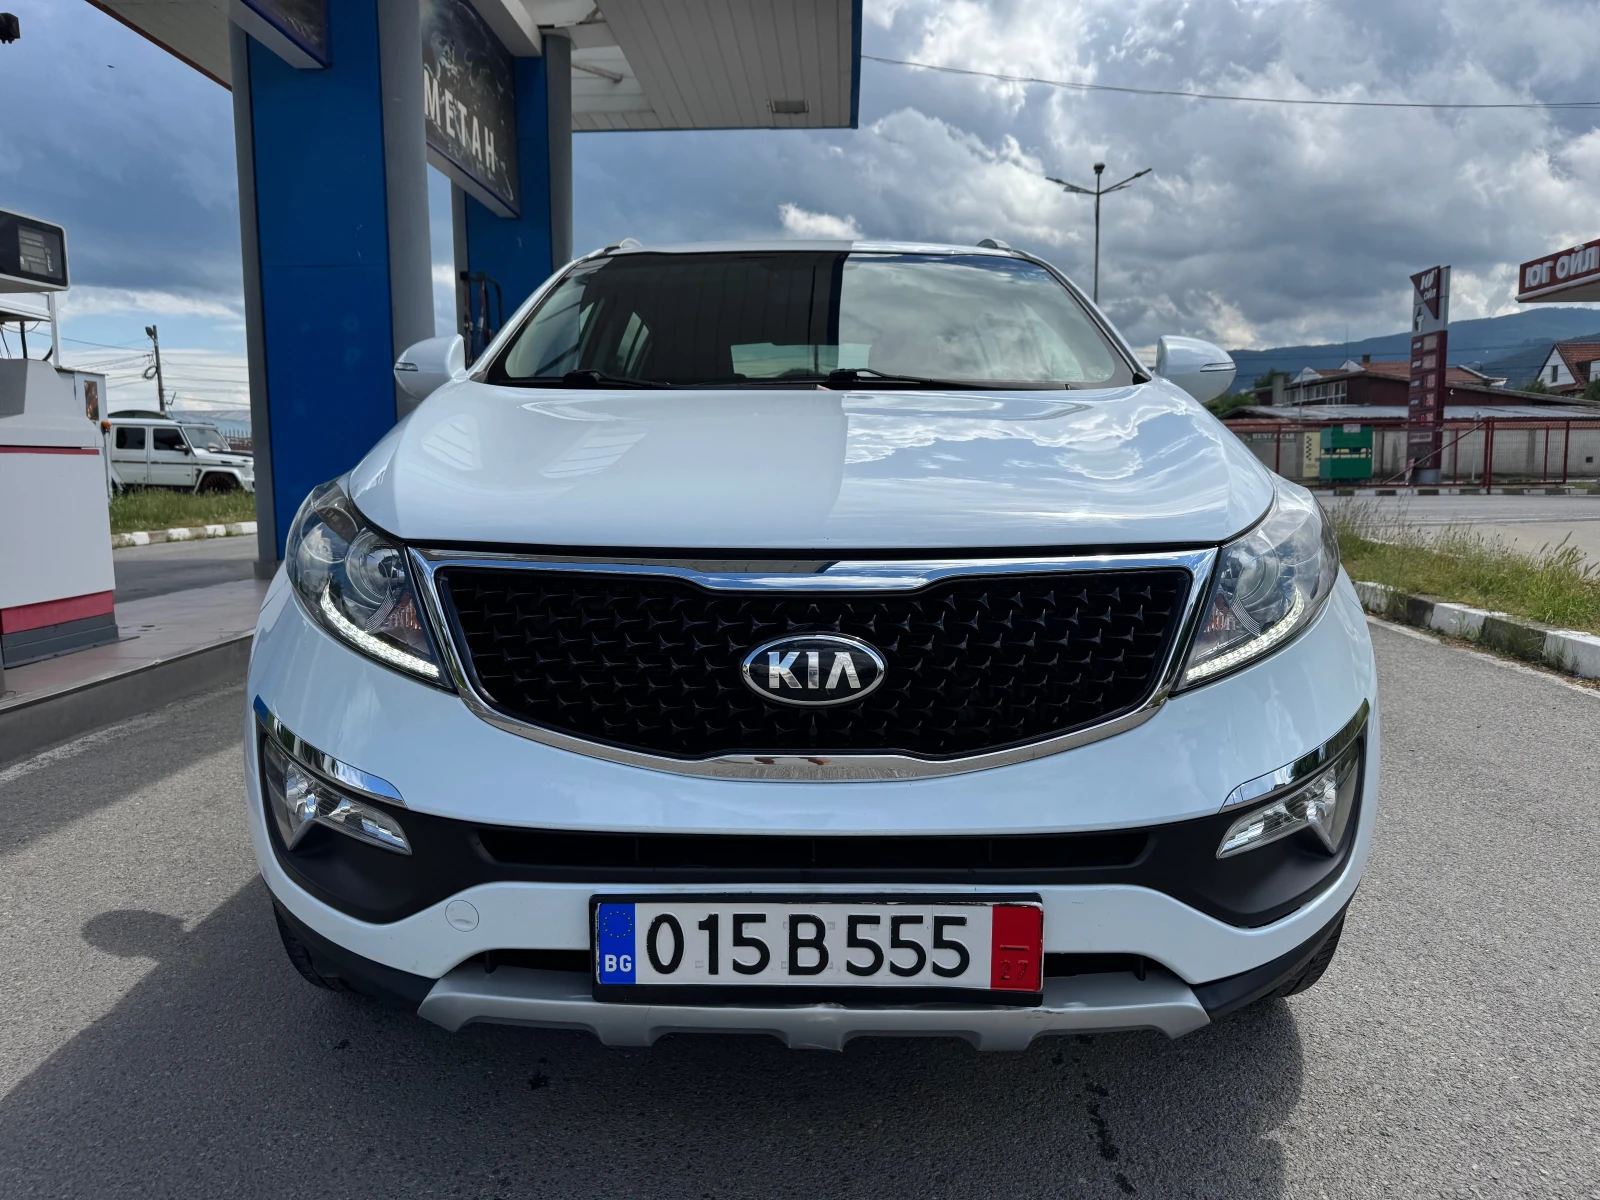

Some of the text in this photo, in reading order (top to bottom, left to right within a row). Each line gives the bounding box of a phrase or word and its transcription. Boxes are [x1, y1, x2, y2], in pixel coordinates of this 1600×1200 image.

[424, 68, 496, 173] МЕТАН
[1525, 244, 1600, 288] ЮГ ОЙЛ
[767, 651, 862, 689] KIA
[604, 954, 632, 973] BG
[1000, 960, 1028, 980] 27
